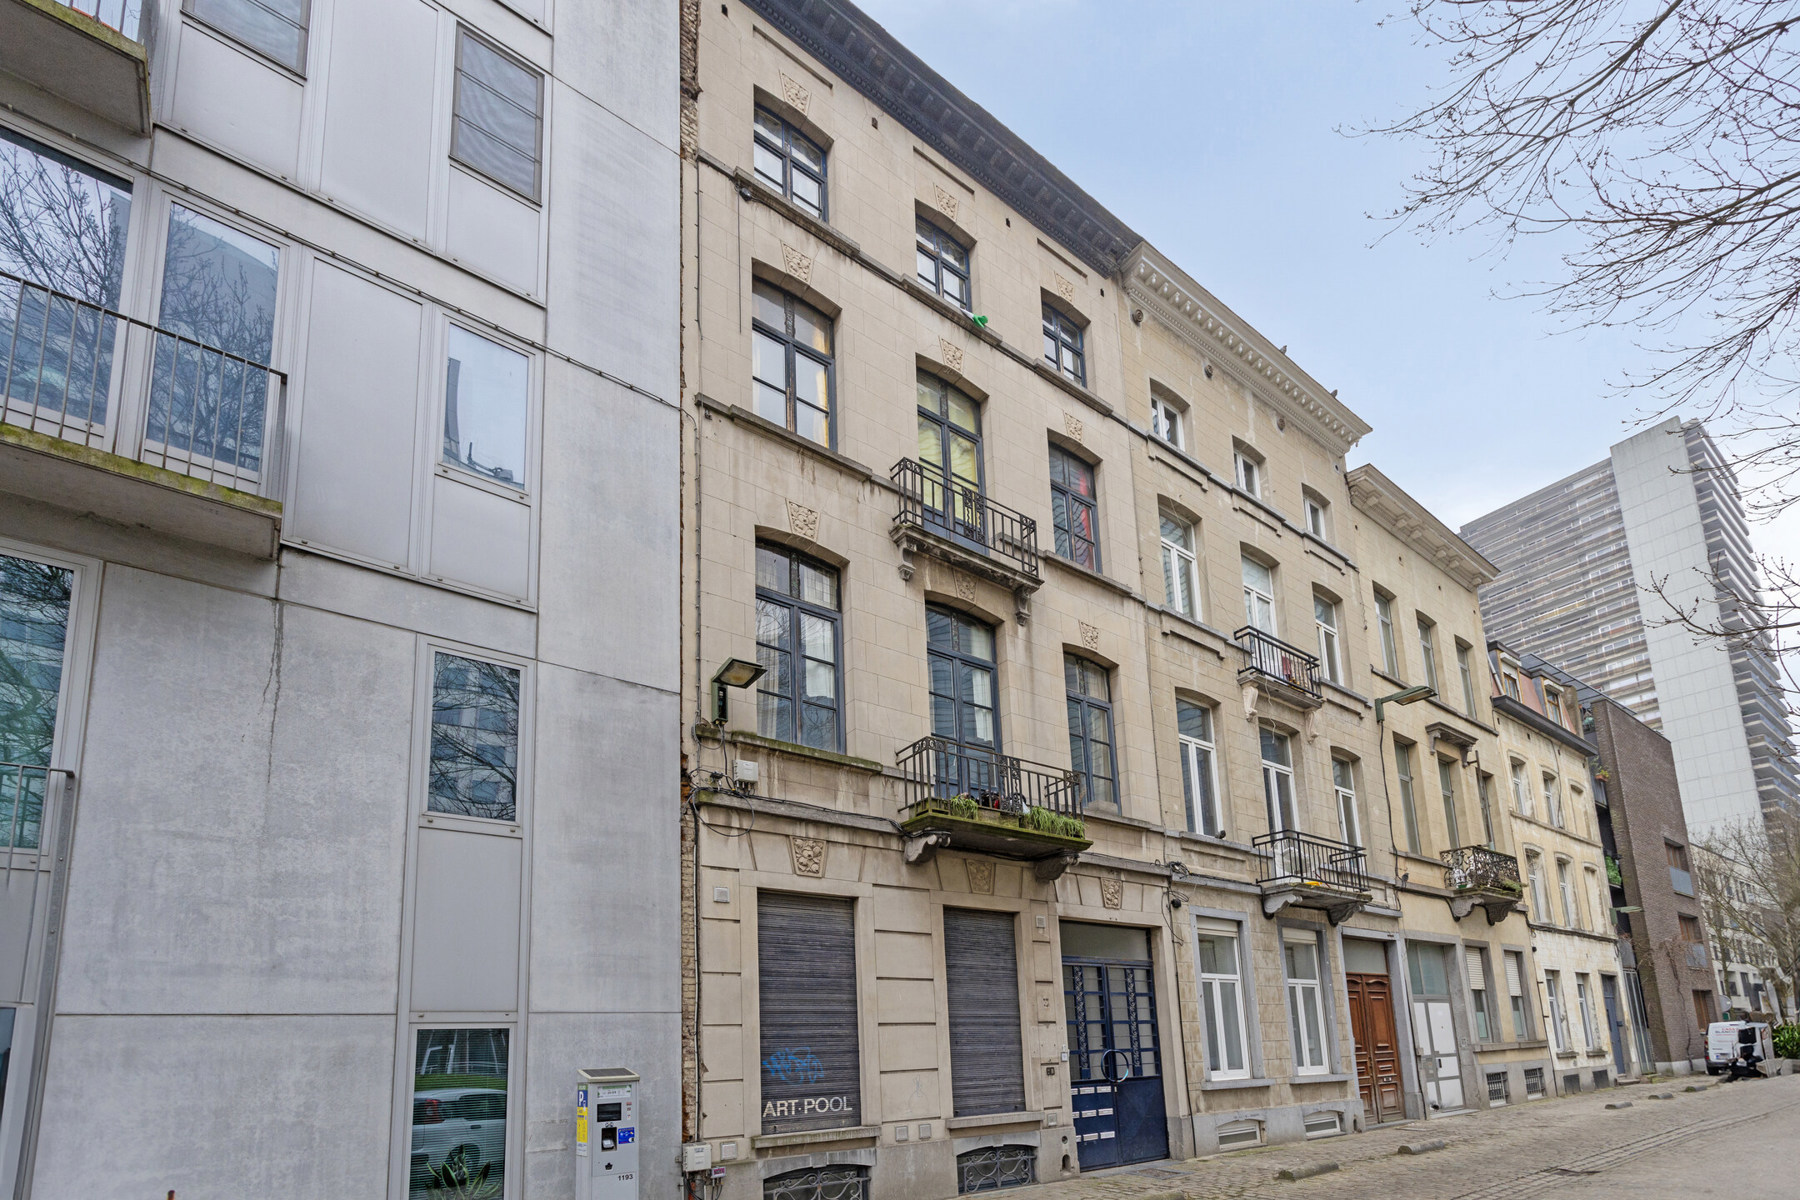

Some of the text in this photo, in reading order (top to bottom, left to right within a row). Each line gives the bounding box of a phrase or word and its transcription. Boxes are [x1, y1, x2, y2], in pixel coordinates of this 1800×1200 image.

[762, 1096, 853, 1118] ART POOL
[618, 1173, 634, 1181] 1193
